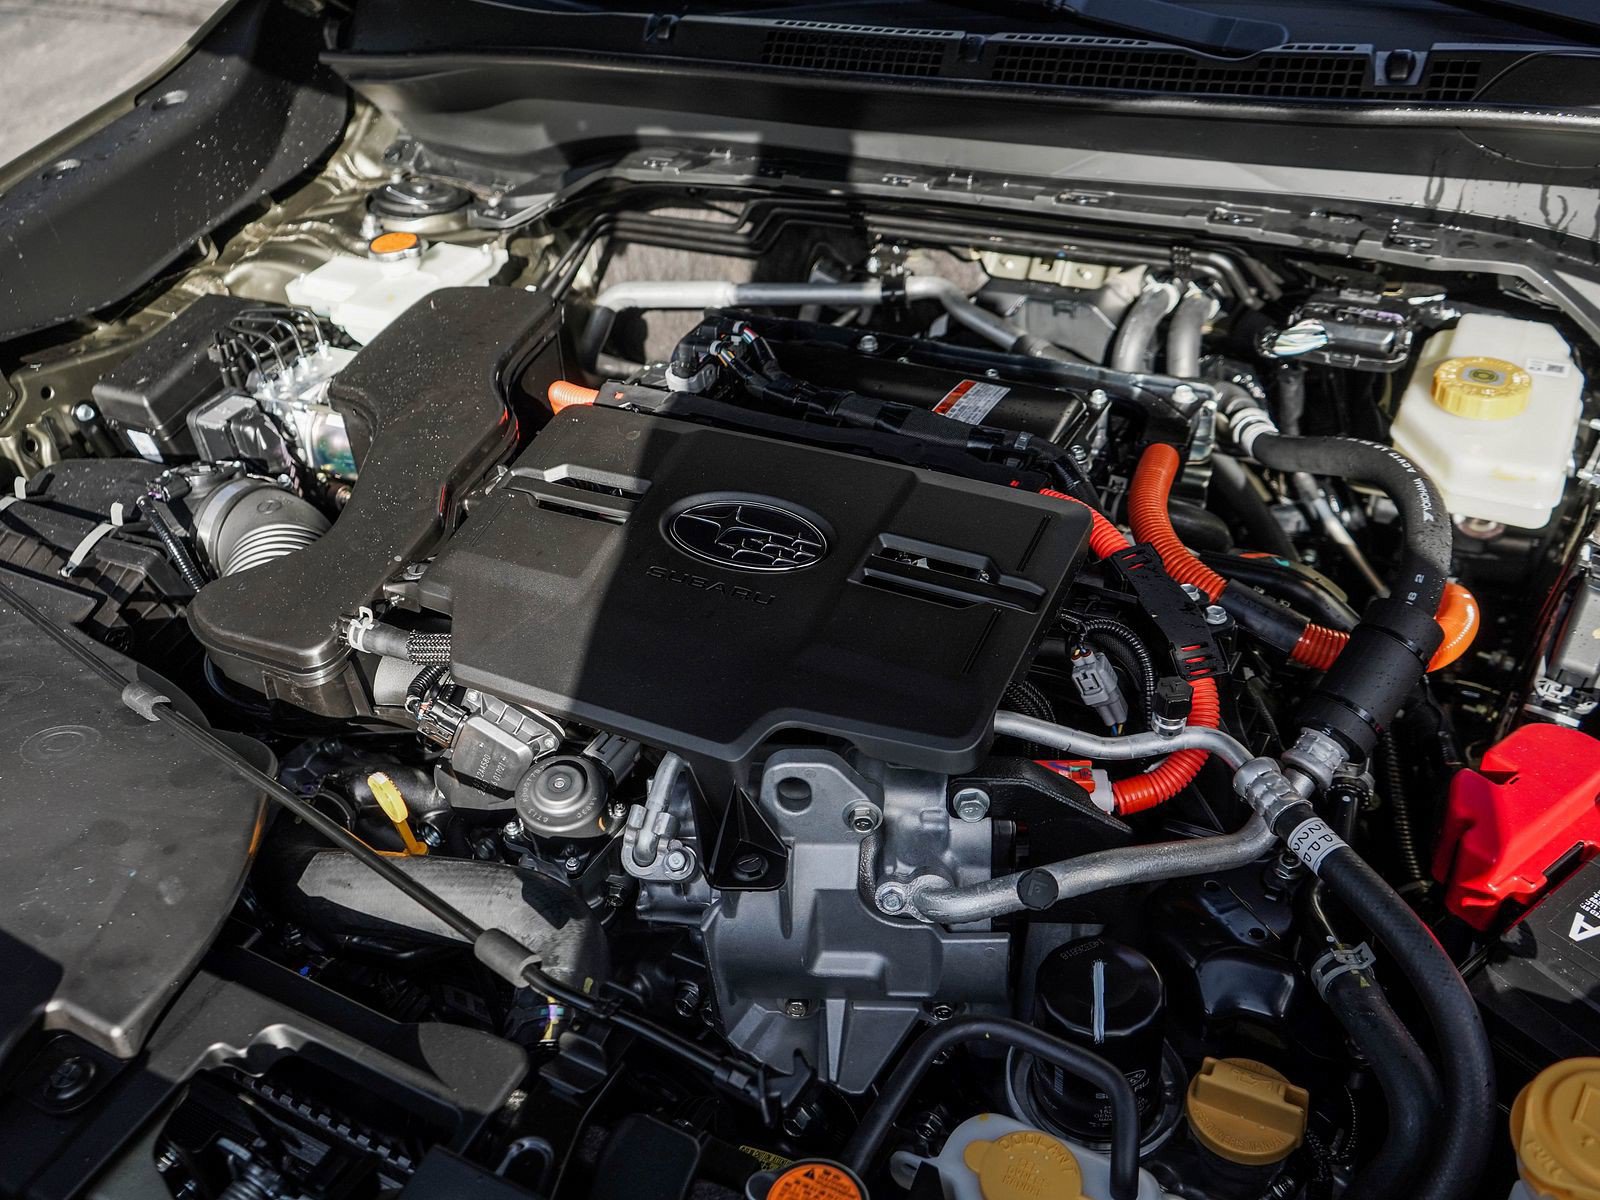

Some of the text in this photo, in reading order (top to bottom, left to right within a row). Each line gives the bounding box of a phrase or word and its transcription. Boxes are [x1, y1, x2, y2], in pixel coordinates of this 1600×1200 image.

[646, 565, 776, 605] SUBARU
[998, 1132, 1080, 1177] COOLANT
[1524, 1140, 1564, 1179] PULL
